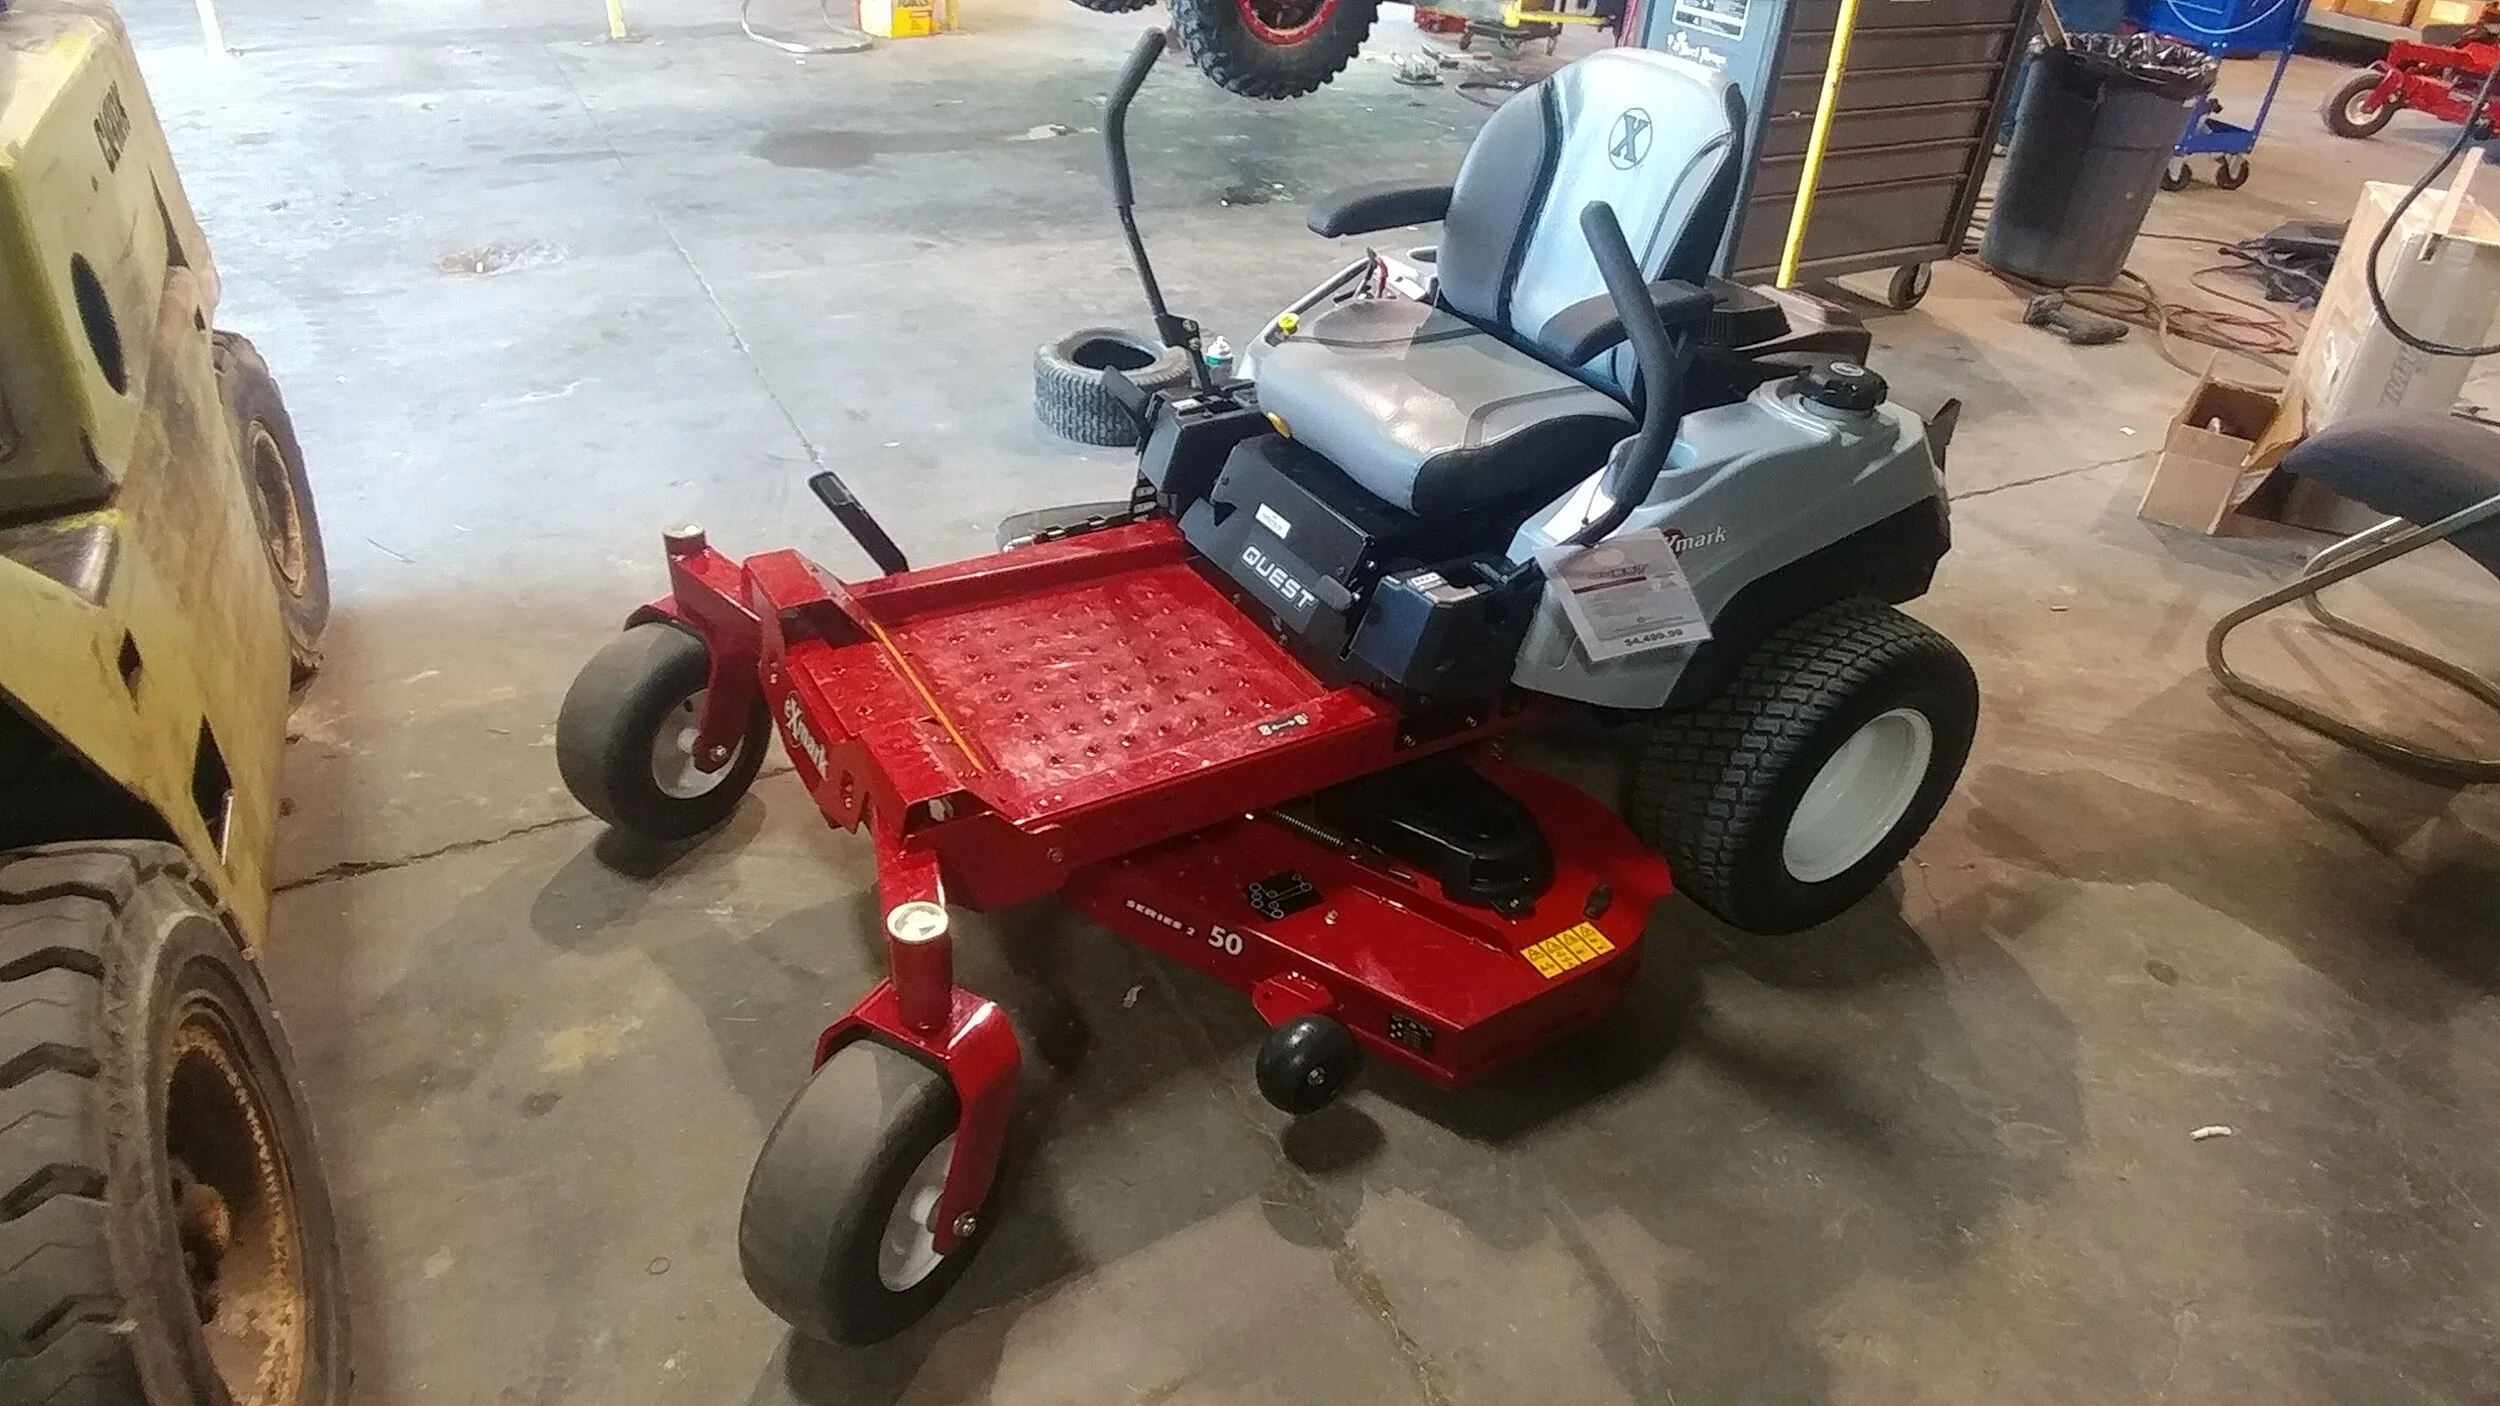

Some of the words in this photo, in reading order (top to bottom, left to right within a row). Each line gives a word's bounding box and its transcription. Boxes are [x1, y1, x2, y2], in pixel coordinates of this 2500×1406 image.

[1242, 546, 1316, 608] QUEST
[1126, 899, 1182, 929] SERIES
[1208, 924, 1243, 956] 50
